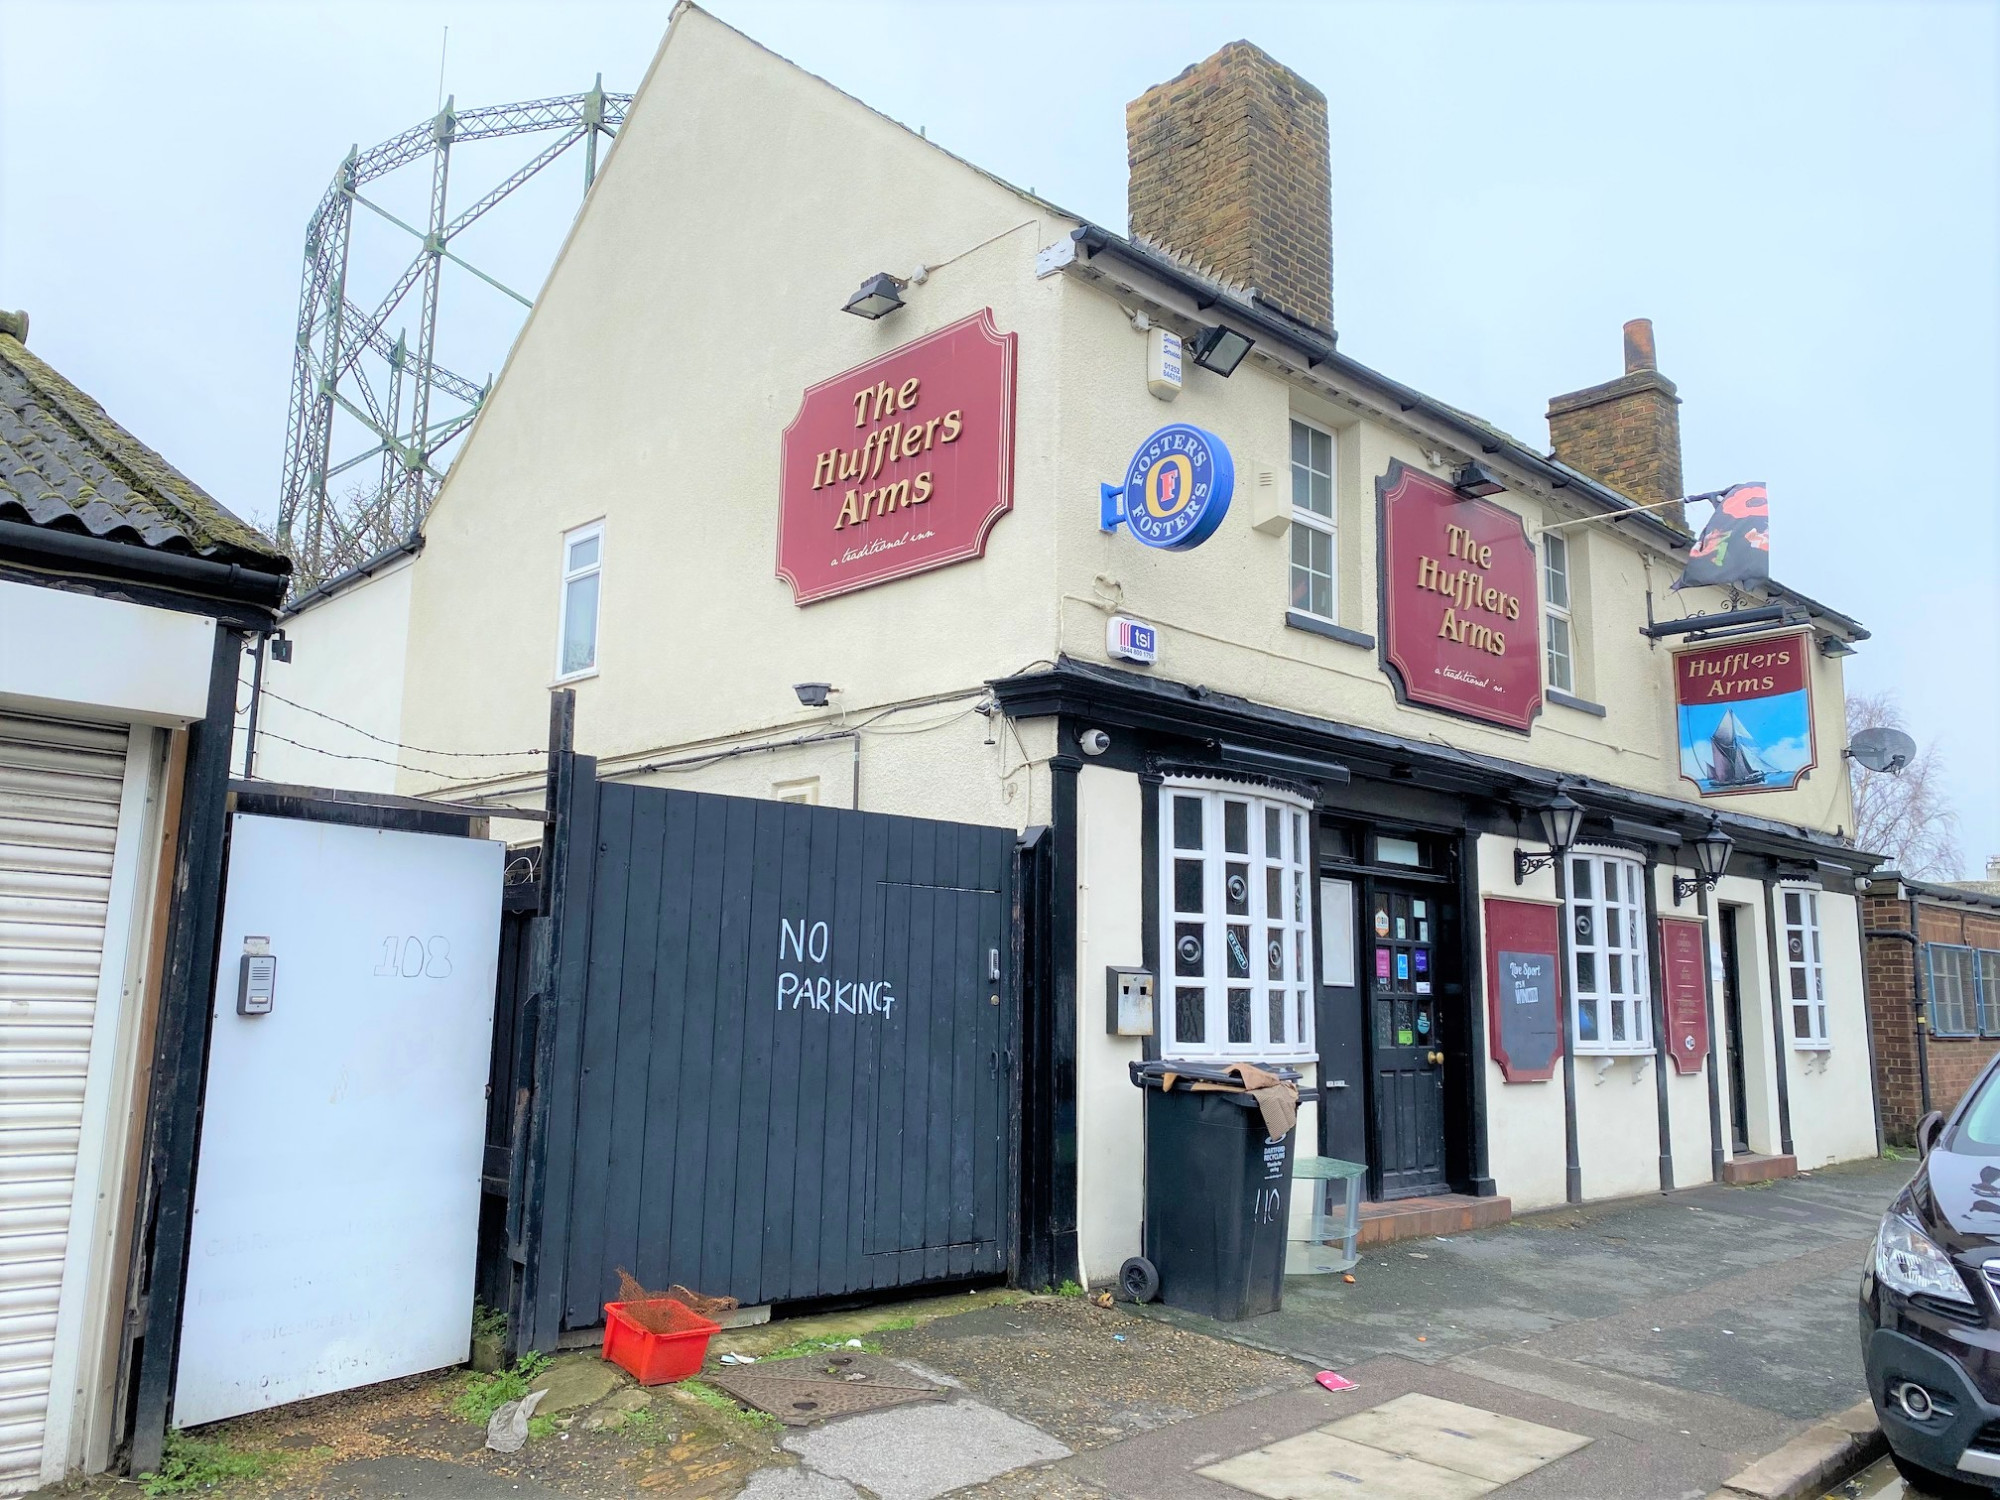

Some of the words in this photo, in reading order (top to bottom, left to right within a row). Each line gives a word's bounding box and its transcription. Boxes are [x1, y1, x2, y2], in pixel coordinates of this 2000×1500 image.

[853, 377, 920, 428] The
[811, 409, 963, 490] Hufflers
[1132, 434, 1207, 487] FOSTER'S
[833, 471, 934, 530] Arms
[1132, 483, 1207, 538] FOSTER'S
[831, 559, 838, 567] a
[841, 531, 909, 563] traditional
[910, 529, 936, 542] inn
[1446, 523, 1492, 569] The
[1416, 555, 1520, 620] Hufflers
[1135, 629, 1150, 649] tsi
[1437, 608, 1506, 657] Arms
[1443, 665, 1489, 688] traditional
[1688, 650, 1790, 678] Hufflers
[1707, 674, 1774, 698] Arms
[374, 935, 452, 978] 108
[780, 918, 828, 963] NO
[1234, 944, 1246, 966] Sport
[1522, 962, 1541, 980] Sport
[777, 972, 895, 1020] PARKING
[1254, 1188, 1280, 1225] 110
